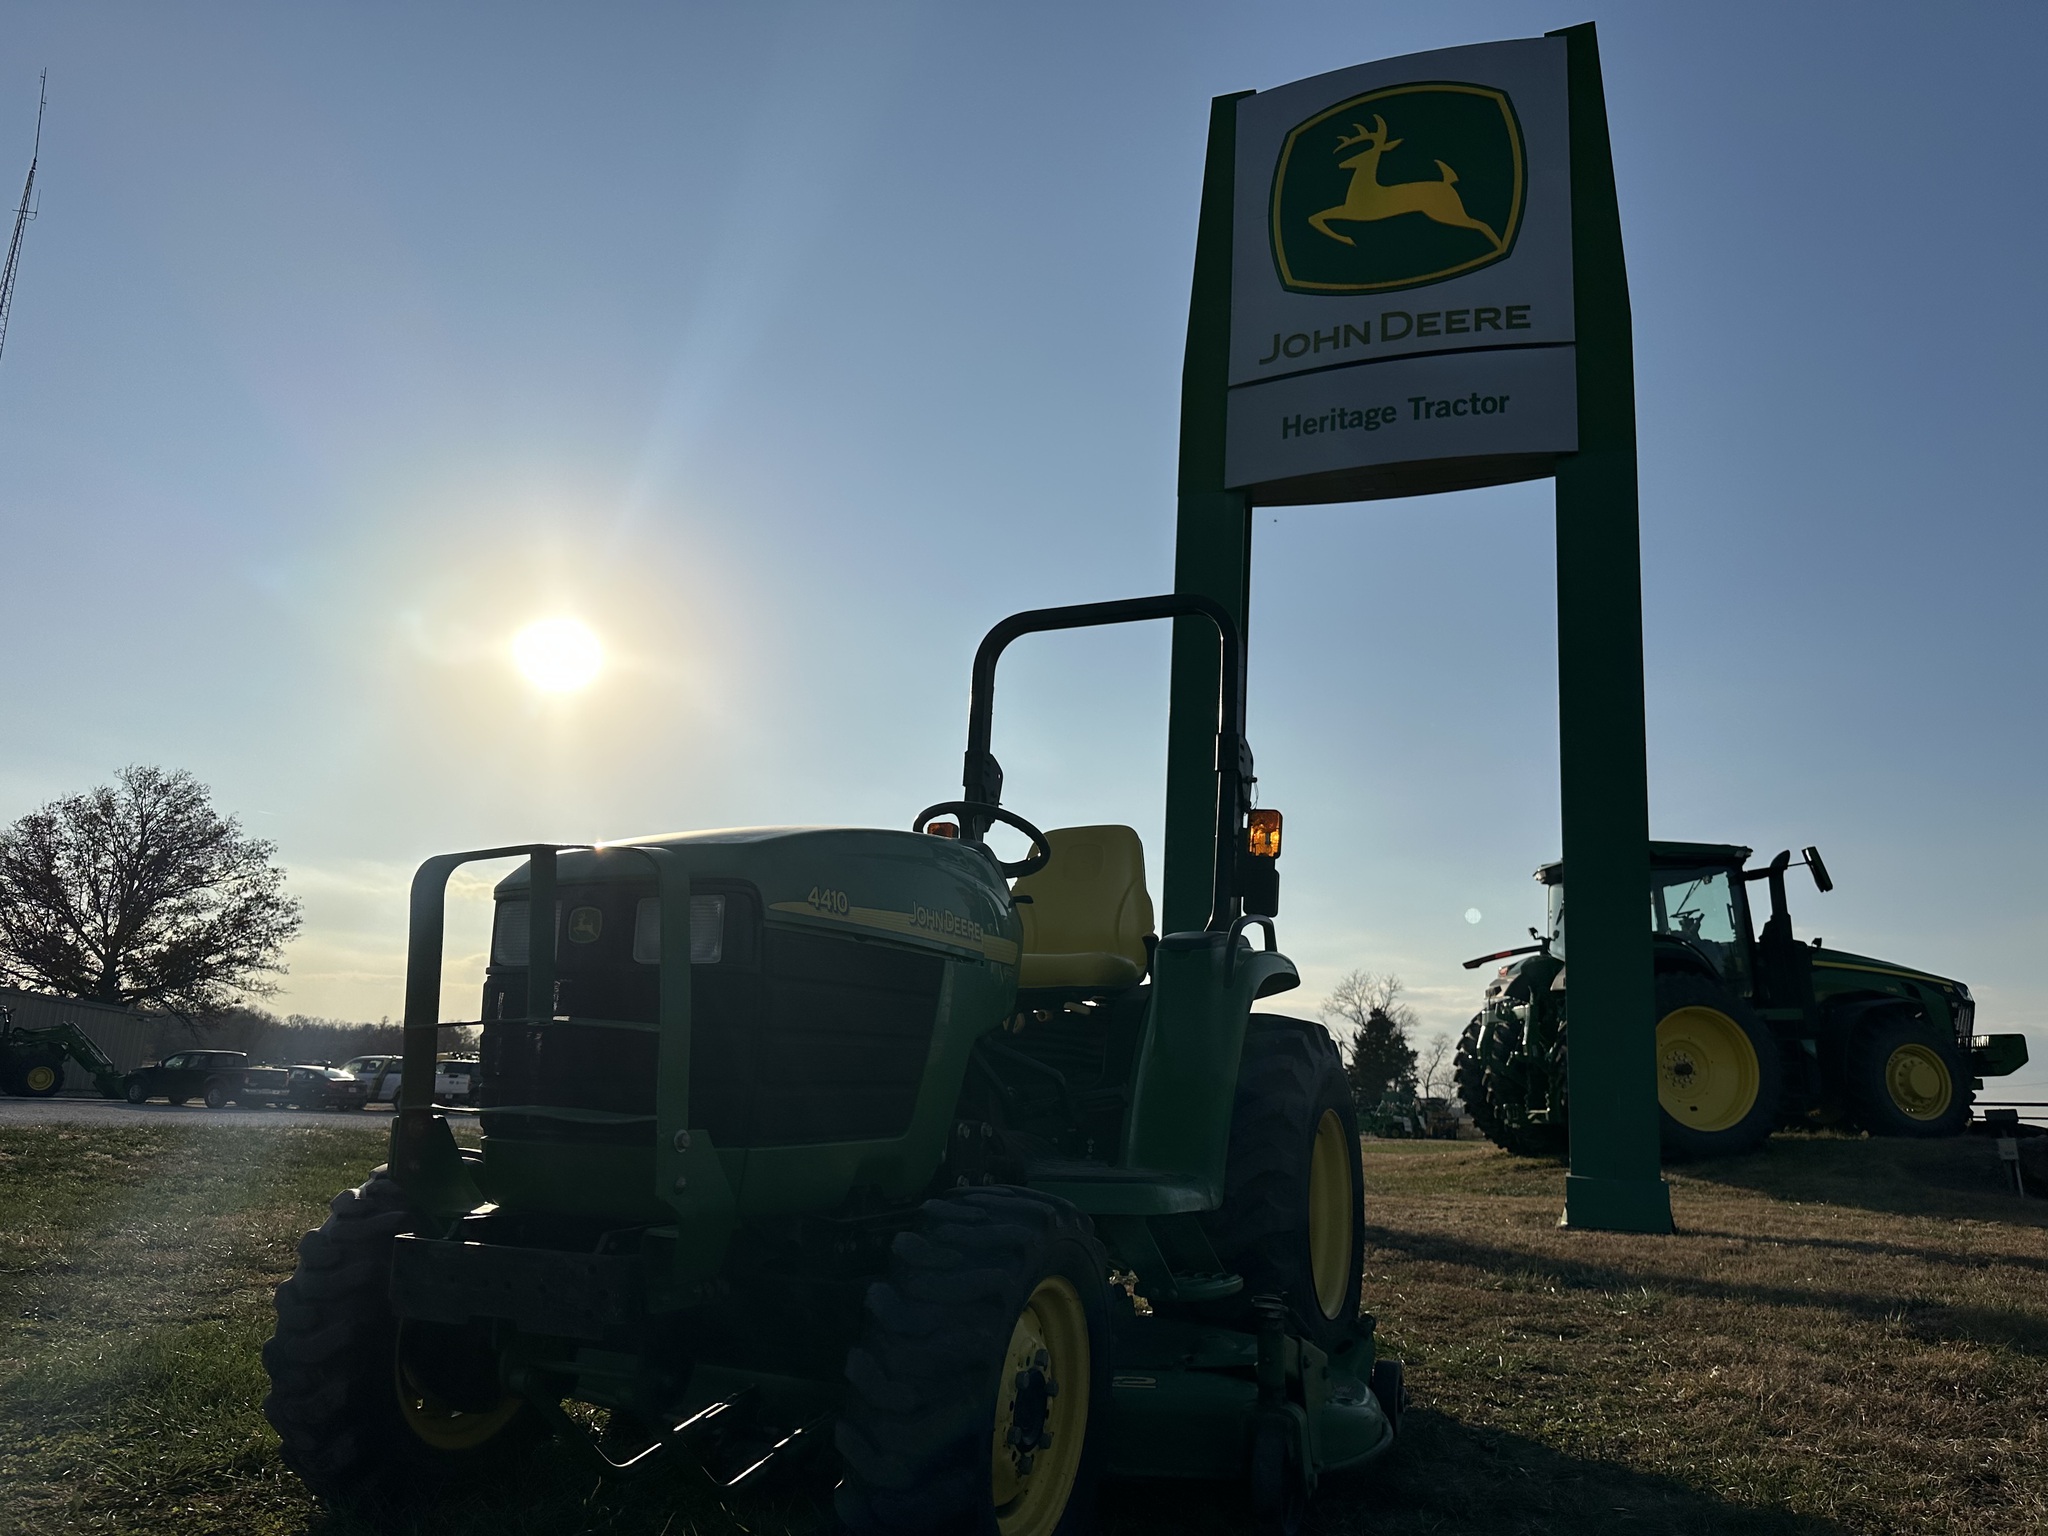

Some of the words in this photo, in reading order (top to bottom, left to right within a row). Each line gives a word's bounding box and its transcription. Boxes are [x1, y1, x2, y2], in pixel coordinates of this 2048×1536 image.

[1259, 320, 1371, 365] JOHN
[1381, 305, 1531, 342] DEERE
[1282, 405, 1397, 440] Heritage
[1408, 392, 1510, 420] Tractor
[808, 885, 848, 913] 4410
[909, 901, 943, 930] JOHN
[944, 909, 982, 941] DEERE
